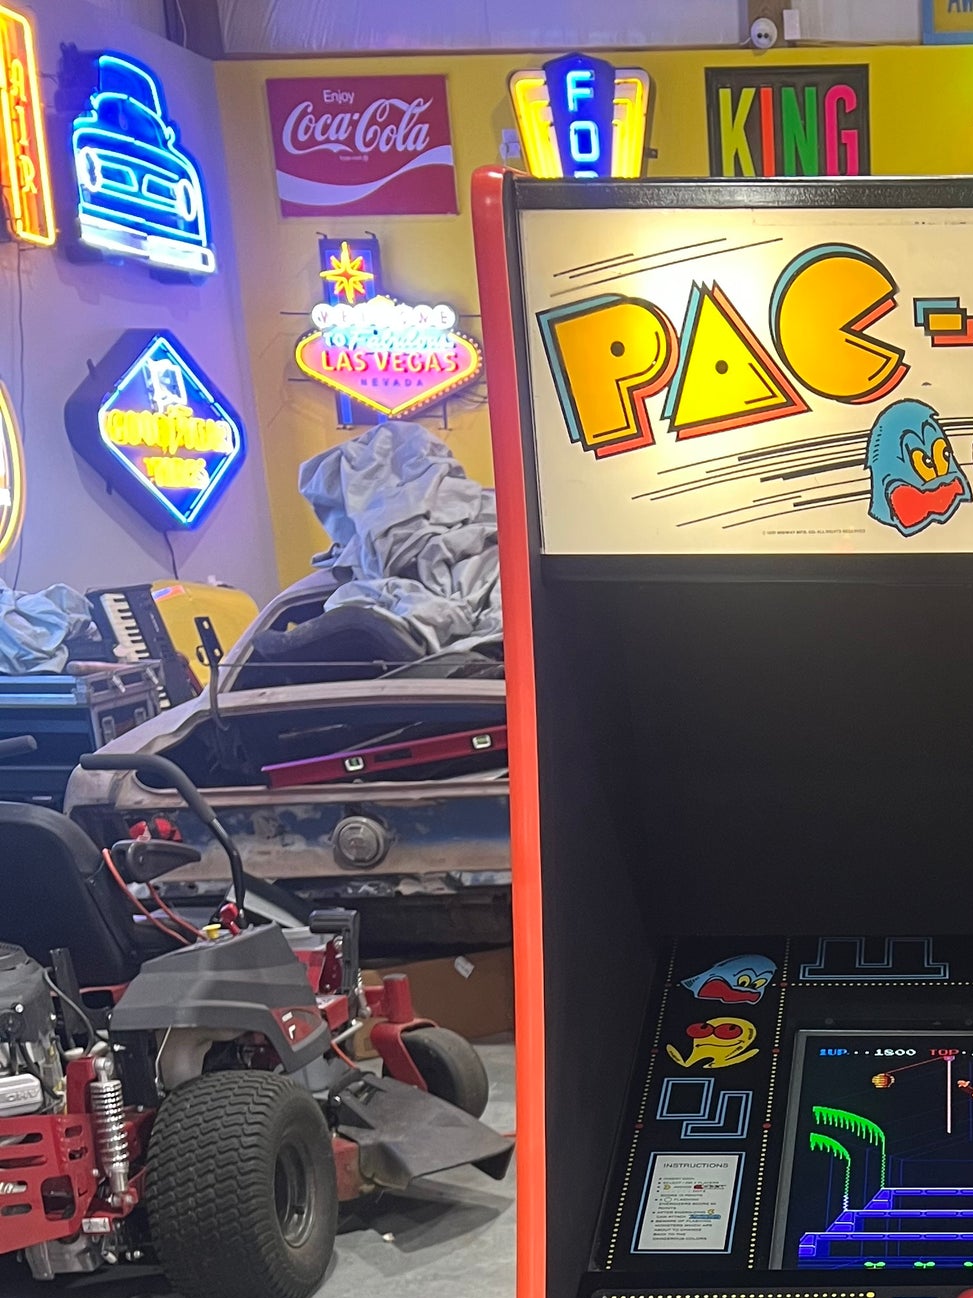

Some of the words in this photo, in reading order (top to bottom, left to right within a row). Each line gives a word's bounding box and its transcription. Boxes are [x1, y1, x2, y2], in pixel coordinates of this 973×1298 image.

[323, 89, 355, 104] Enjoy
[282, 97, 434, 155] Coca-Cola
[566, 70, 600, 178] FO
[719, 84, 858, 177] KING
[321, 351, 368, 372] LAS
[373, 351, 459, 373] VEGAS
[360, 378, 425, 388] NEVADA
[930, 1048, 960, 1056] TOP
